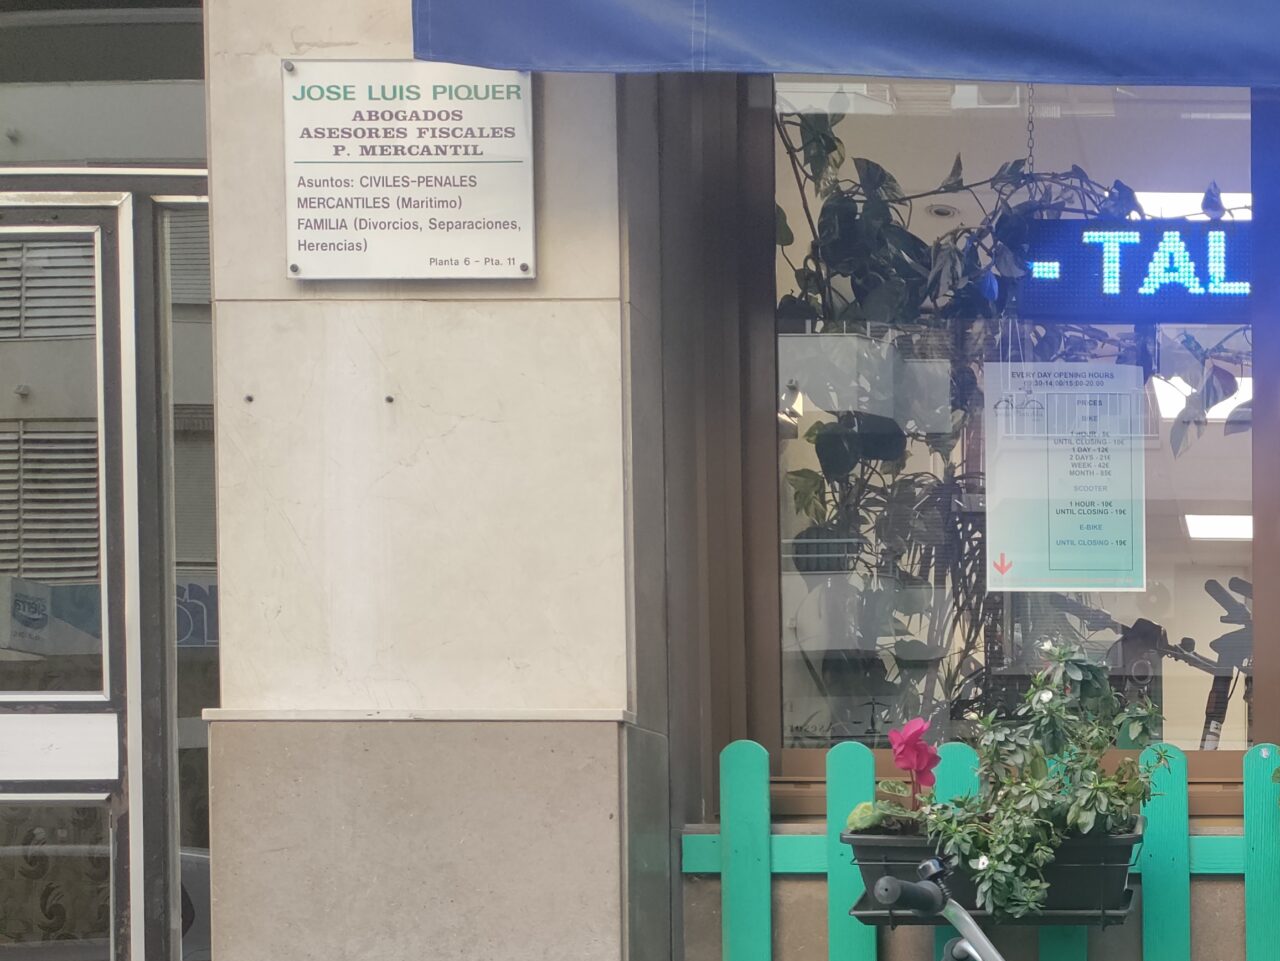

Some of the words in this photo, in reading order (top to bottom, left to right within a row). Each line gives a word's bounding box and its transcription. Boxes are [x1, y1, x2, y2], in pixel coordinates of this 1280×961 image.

[292, 85, 356, 101] JOSE
[367, 84, 421, 101] LUIS
[432, 84, 522, 101] PIQUER
[352, 109, 464, 122] ABOGADOS
[299, 127, 408, 139] ASESORES
[416, 127, 516, 139] FISCALES
[332, 144, 351, 157] P.
[358, 144, 484, 157] MERCANTIL
[297, 175, 354, 189] Asuntos:
[359, 175, 477, 188] CIVILES-PENALES
[297, 197, 390, 209] MERCANTILES
[297, 218, 348, 231] FAMILIA
[353, 217, 424, 233] (Divorcios,
[428, 217, 522, 233] Separaciones,
[297, 238, 368, 253] Herencias)
[429, 257, 459, 266] Planta
[464, 257, 471, 266] 6
[484, 257, 503, 266] Pta.
[506, 257, 516, 266] 11
[1037, 371, 1051, 379] DAY
[1053, 371, 1087, 379] OPENING
[1088, 371, 1115, 379] HOURS
